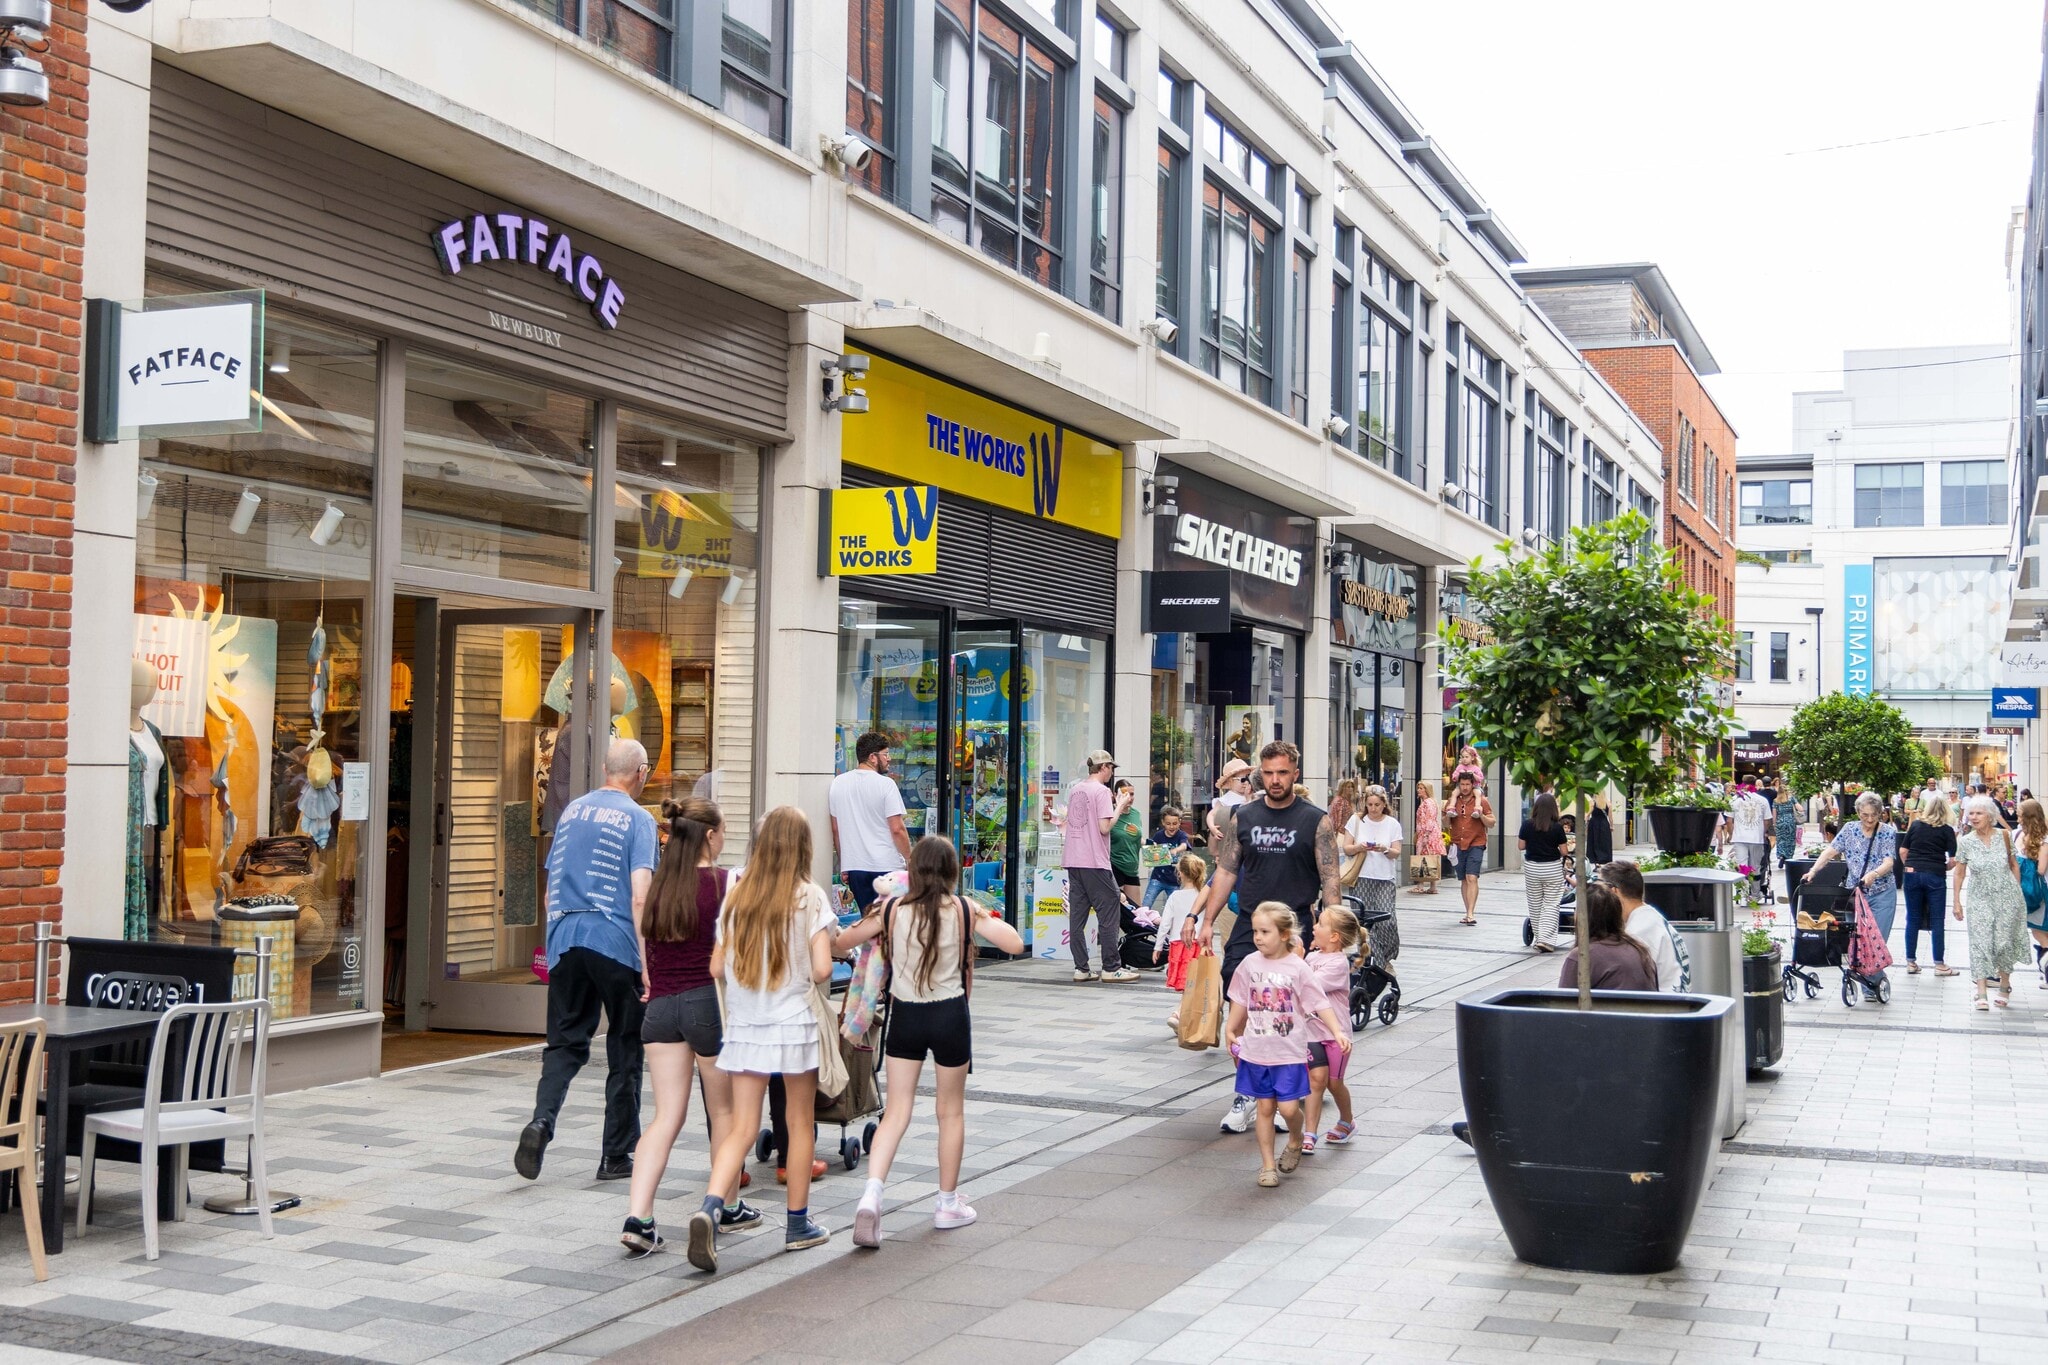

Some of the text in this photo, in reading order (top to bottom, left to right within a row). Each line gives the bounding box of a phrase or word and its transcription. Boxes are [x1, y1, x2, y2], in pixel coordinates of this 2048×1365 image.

[433, 212, 626, 330] FATFACE
[488, 311, 563, 348] NEWBURY
[128, 346, 242, 387] FATFACE
[926, 413, 960, 456] THE
[963, 425, 1026, 478] WORKS
[839, 535, 867, 549] THE
[1170, 513, 1303, 587] SKECHERS
[839, 549, 913, 568] WORKS
[1160, 597, 1221, 606] SKECHERS
[1849, 594, 1867, 697] PRIMARK
[2007, 652, 2048, 673] Artisa
[157, 674, 184, 692] UIT
[916, 678, 937, 694] £2
[1995, 703, 2034, 711] TRESPASS
[1993, 727, 2014, 735] EWM
[1749, 750, 1774, 759] BREAK
[348, 949, 356, 964] B
